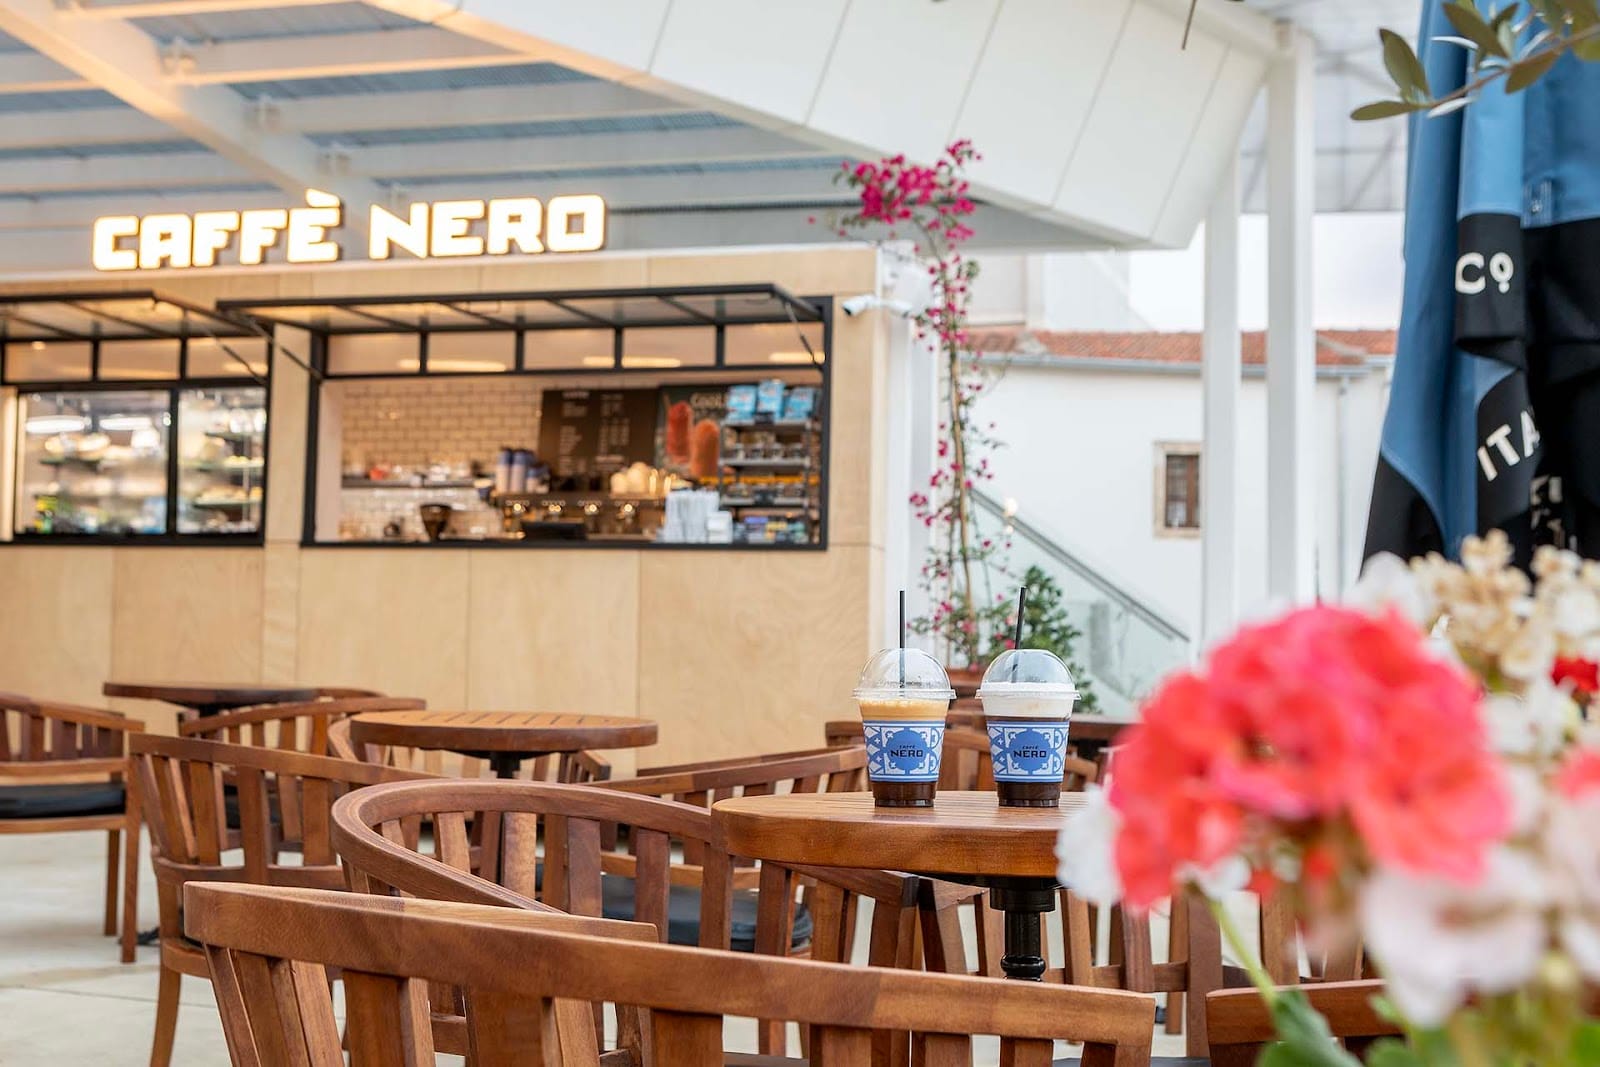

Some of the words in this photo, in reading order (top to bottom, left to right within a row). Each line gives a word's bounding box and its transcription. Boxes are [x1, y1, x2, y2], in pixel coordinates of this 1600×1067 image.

[93, 188, 342, 270] CAFFÈ
[369, 195, 605, 260] NERO
[1013, 750, 1047, 758] NERO
